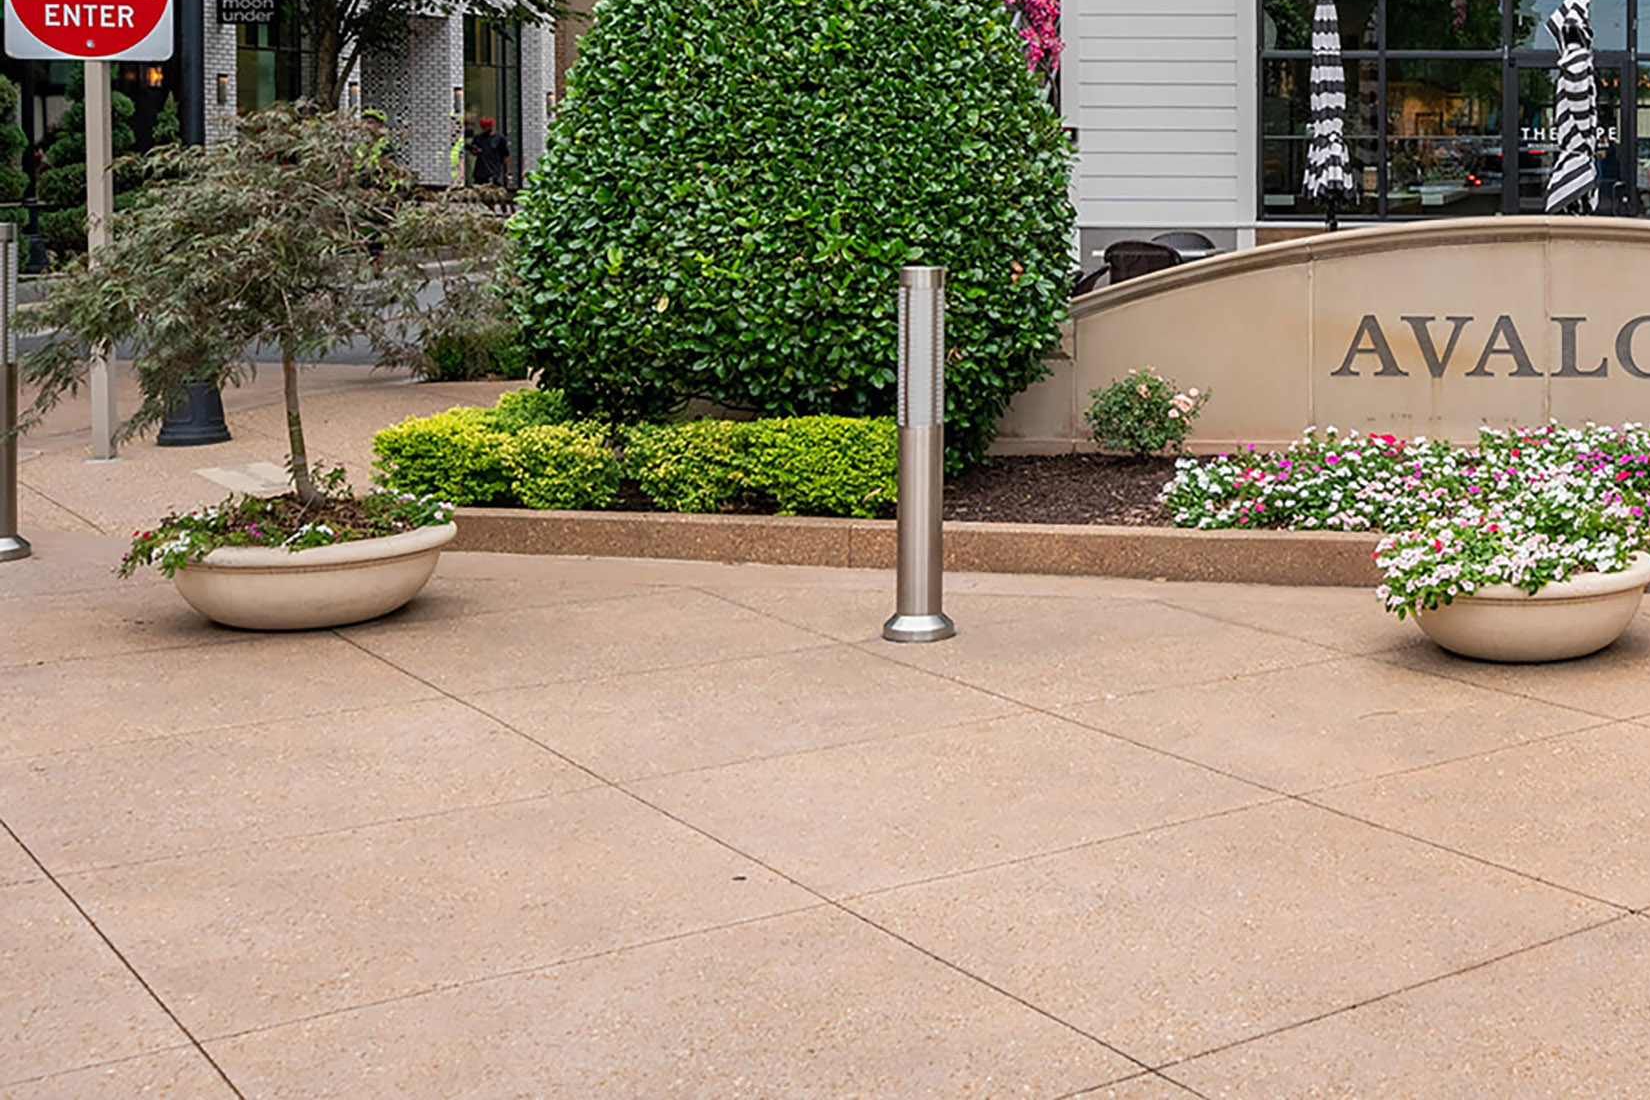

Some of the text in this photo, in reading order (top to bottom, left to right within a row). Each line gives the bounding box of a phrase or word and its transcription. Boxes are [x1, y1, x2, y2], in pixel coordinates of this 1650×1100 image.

[45, 3, 134, 28] ENTER
[222, 9, 274, 22] under
[1520, 126, 1558, 141] THE
